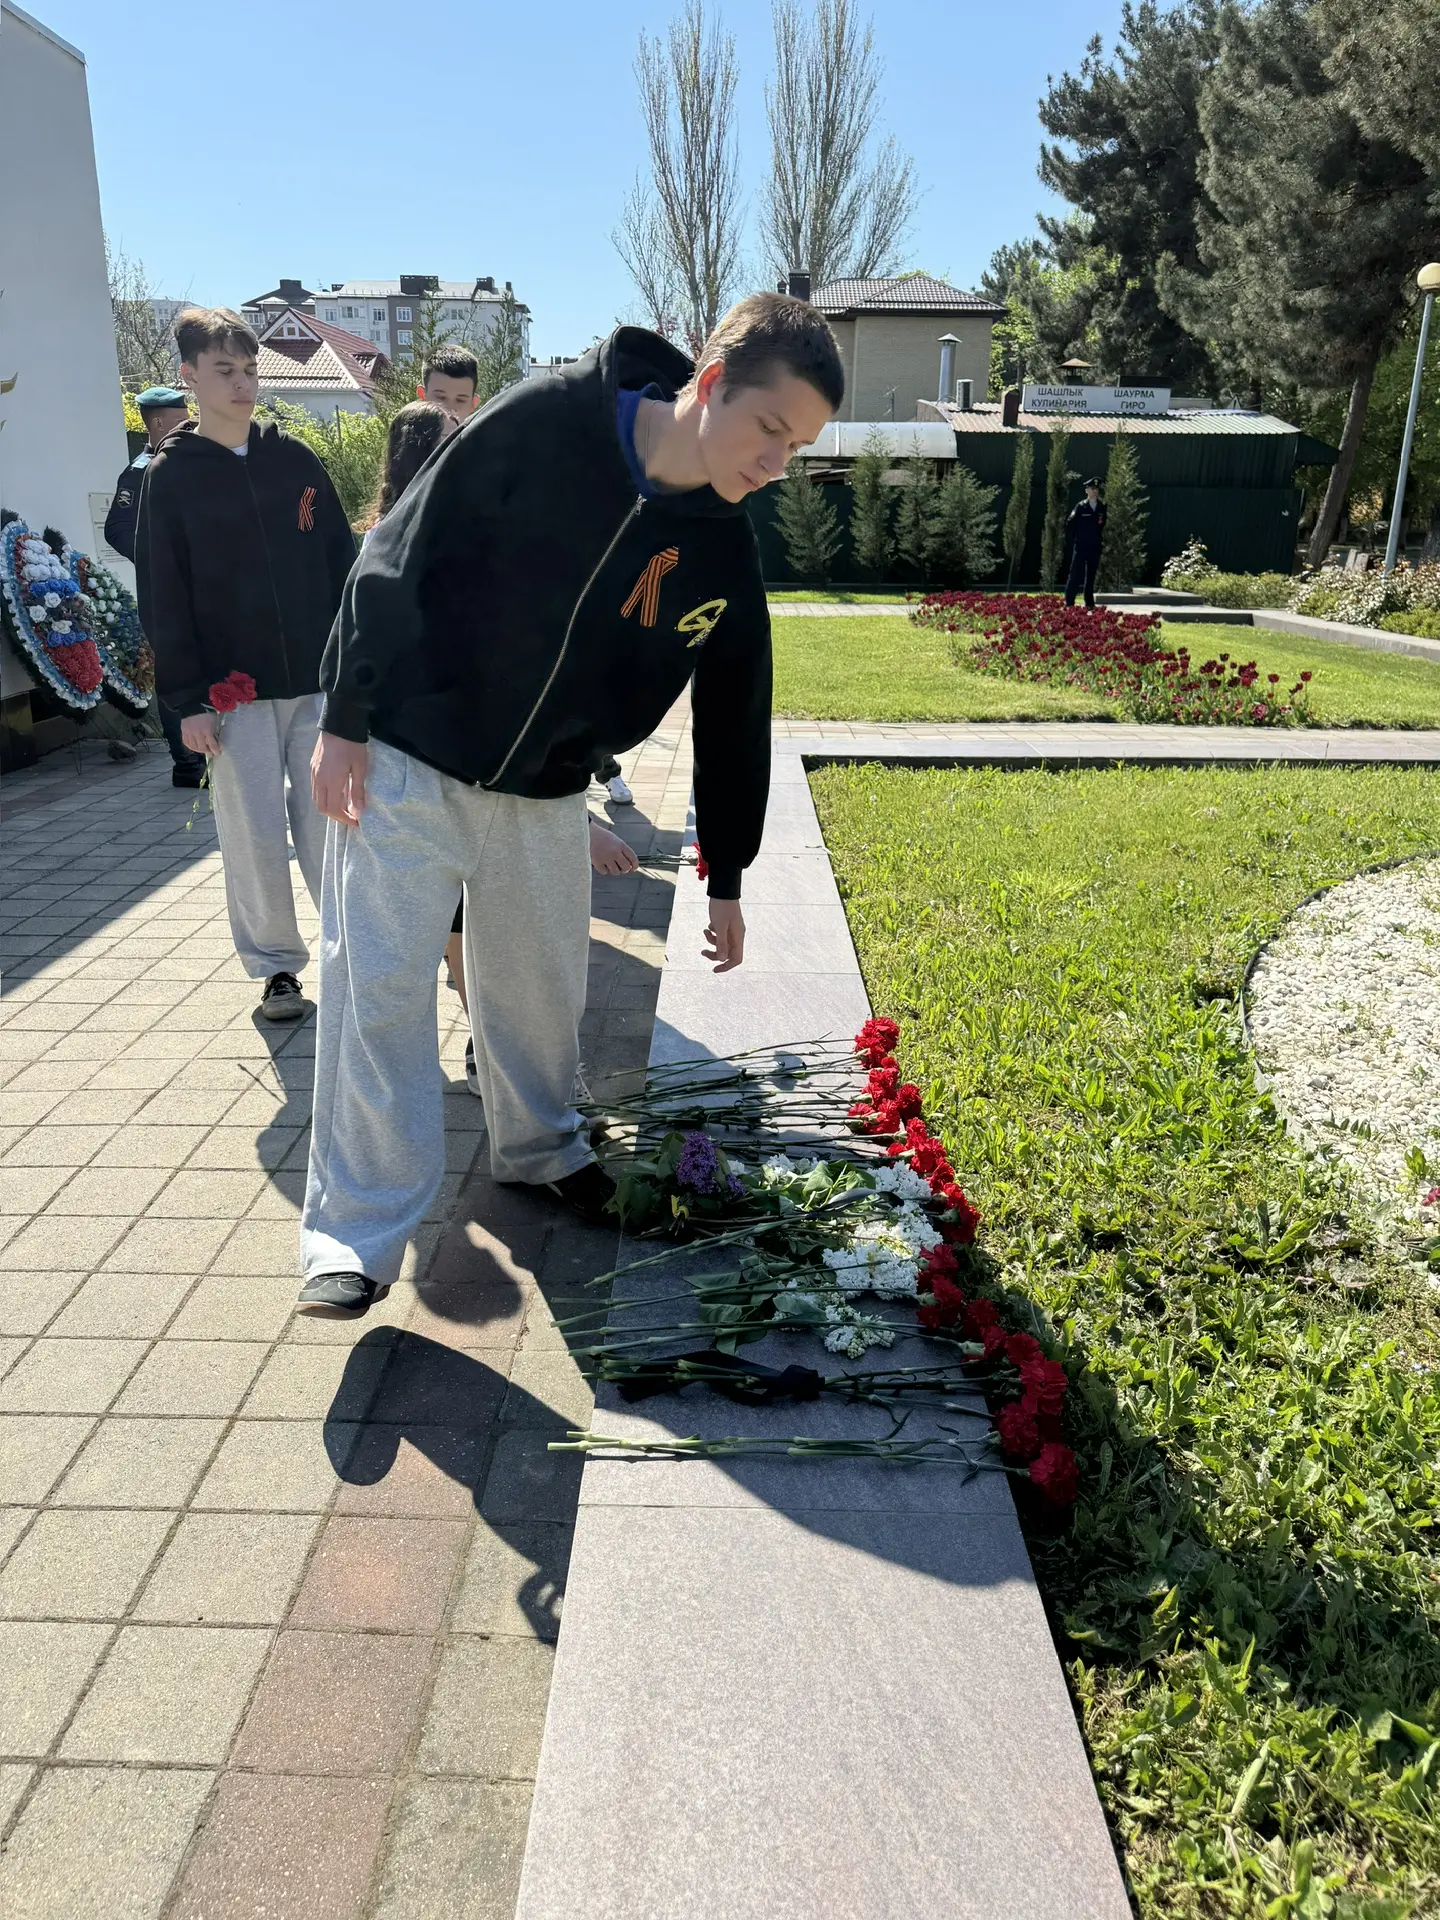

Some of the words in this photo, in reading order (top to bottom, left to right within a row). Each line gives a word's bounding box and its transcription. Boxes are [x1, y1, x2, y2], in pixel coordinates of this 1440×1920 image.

[1037, 387, 1084, 397] ШАШЛЫК
[1114, 389, 1155, 399] ШАУРМА
[1031, 399, 1087, 409] КУЛИНАРИЯ
[1120, 400, 1146, 410] ГИРО
